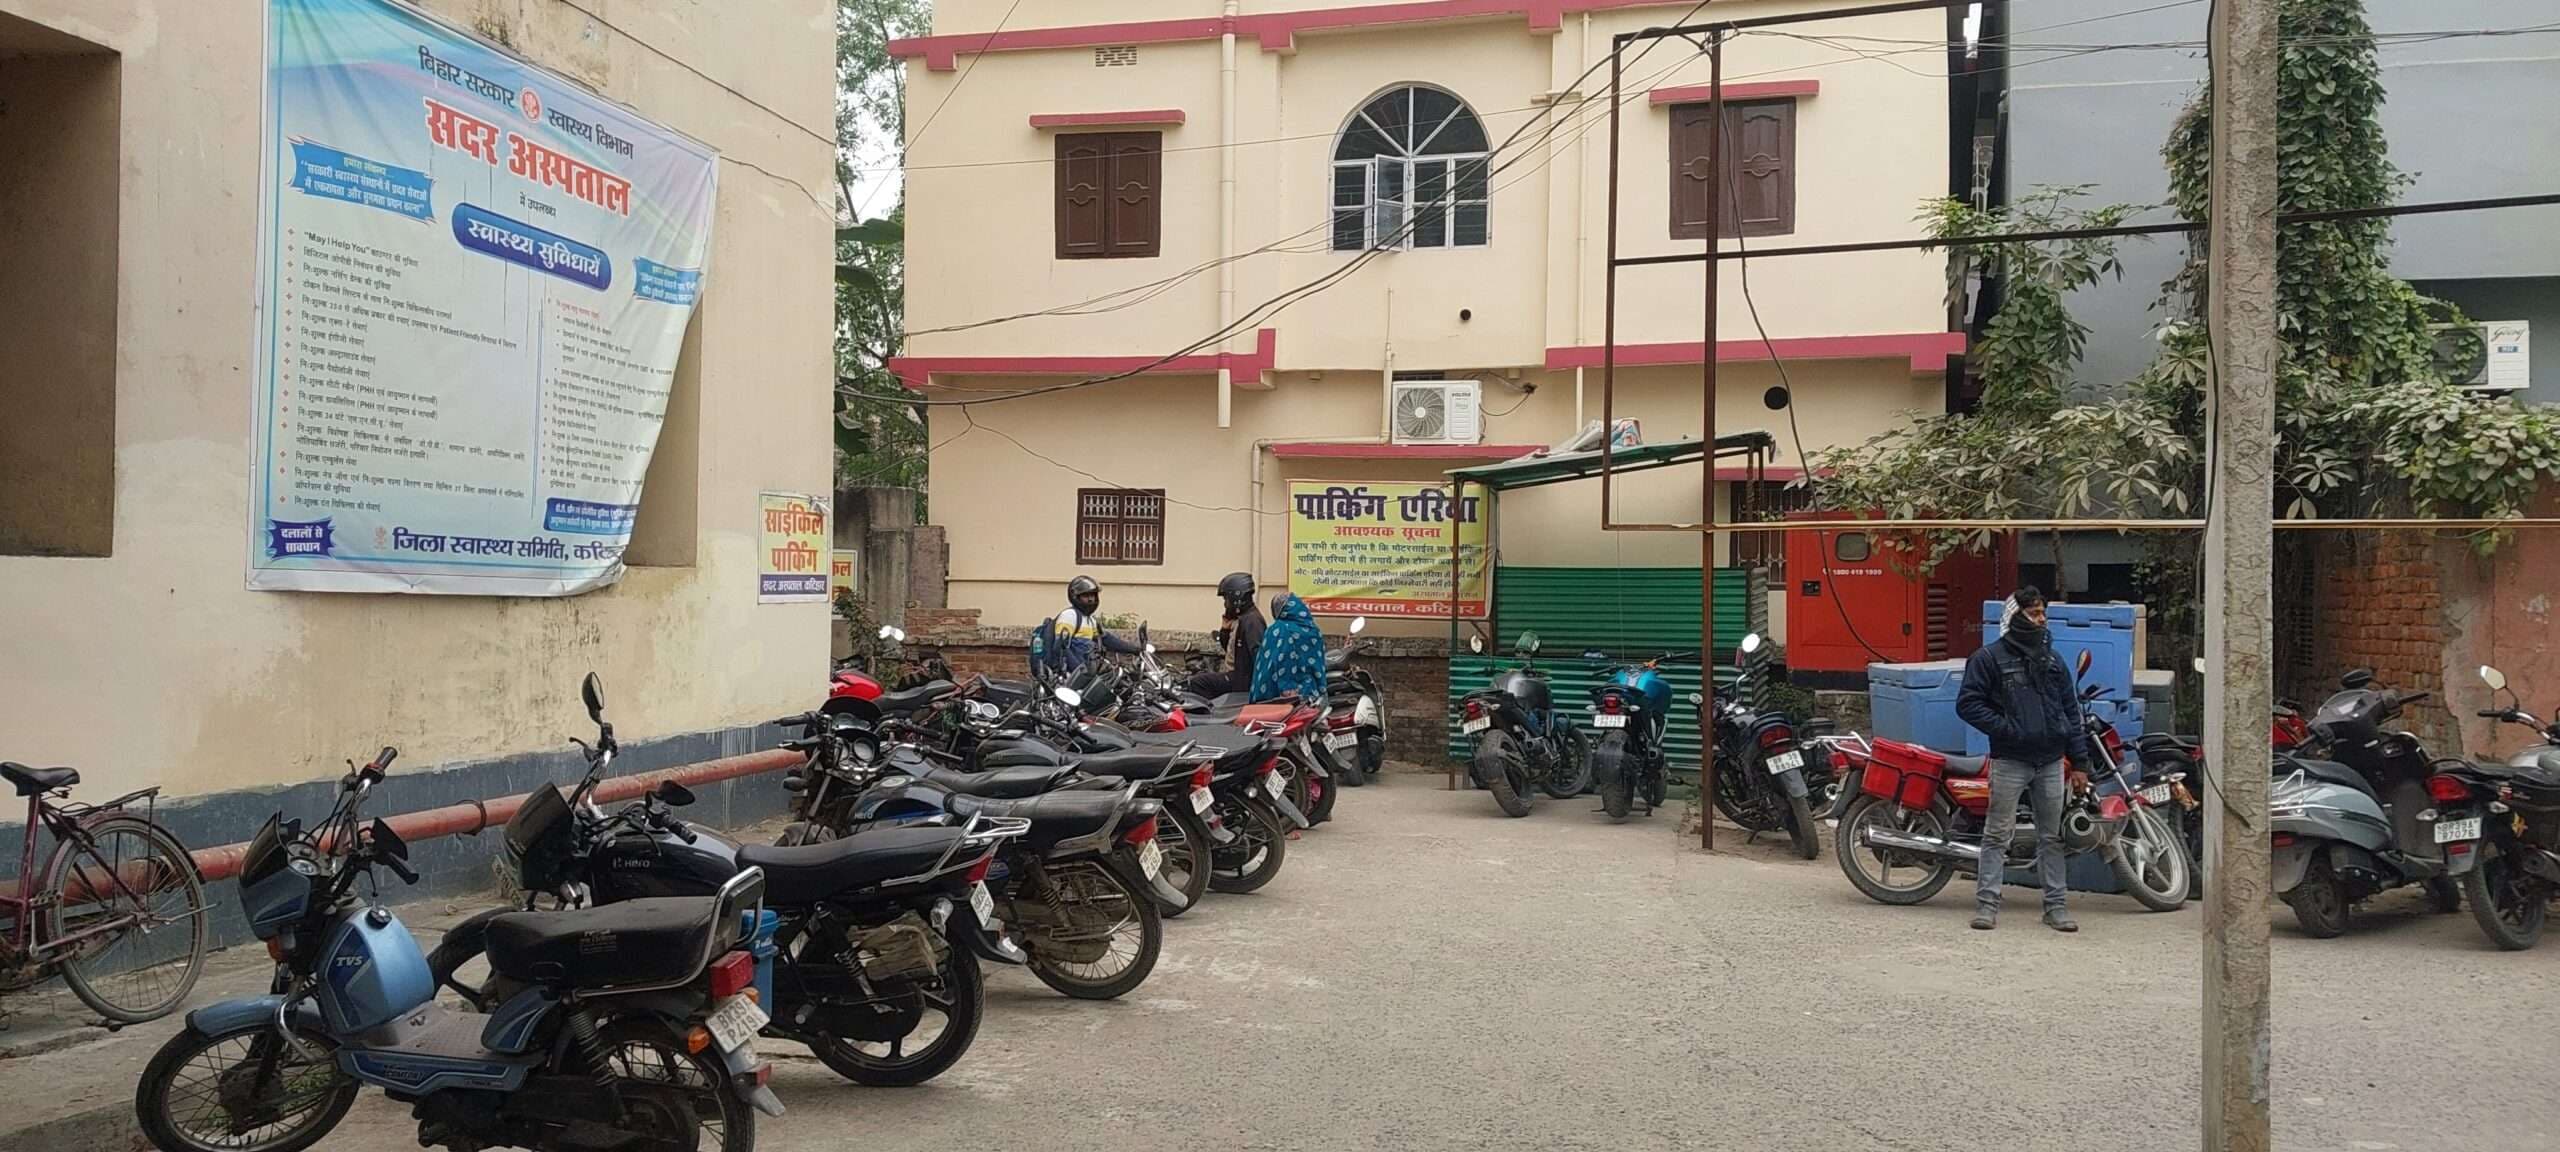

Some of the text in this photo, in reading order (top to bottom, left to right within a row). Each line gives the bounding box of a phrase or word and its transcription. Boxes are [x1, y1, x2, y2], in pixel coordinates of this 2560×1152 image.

[419, 45, 634, 159] बिहार सरकार स्वास्थ्य विभाग
[424, 97, 632, 217] सदर अस्पताल
[467, 217, 601, 278] स्वास्थ्य सुविधायें
[281, 526, 313, 539] दलालों
[1333, 526, 1441, 542] आवश्यक सूचना
[285, 542, 320, 553] सावधान
[391, 526, 446, 553] जिला
[449, 535, 514, 557] स्वास्थ्य
[517, 536, 569, 562] समिति,
[763, 580, 777, 591] सदर
[336, 955, 363, 967] TVS
